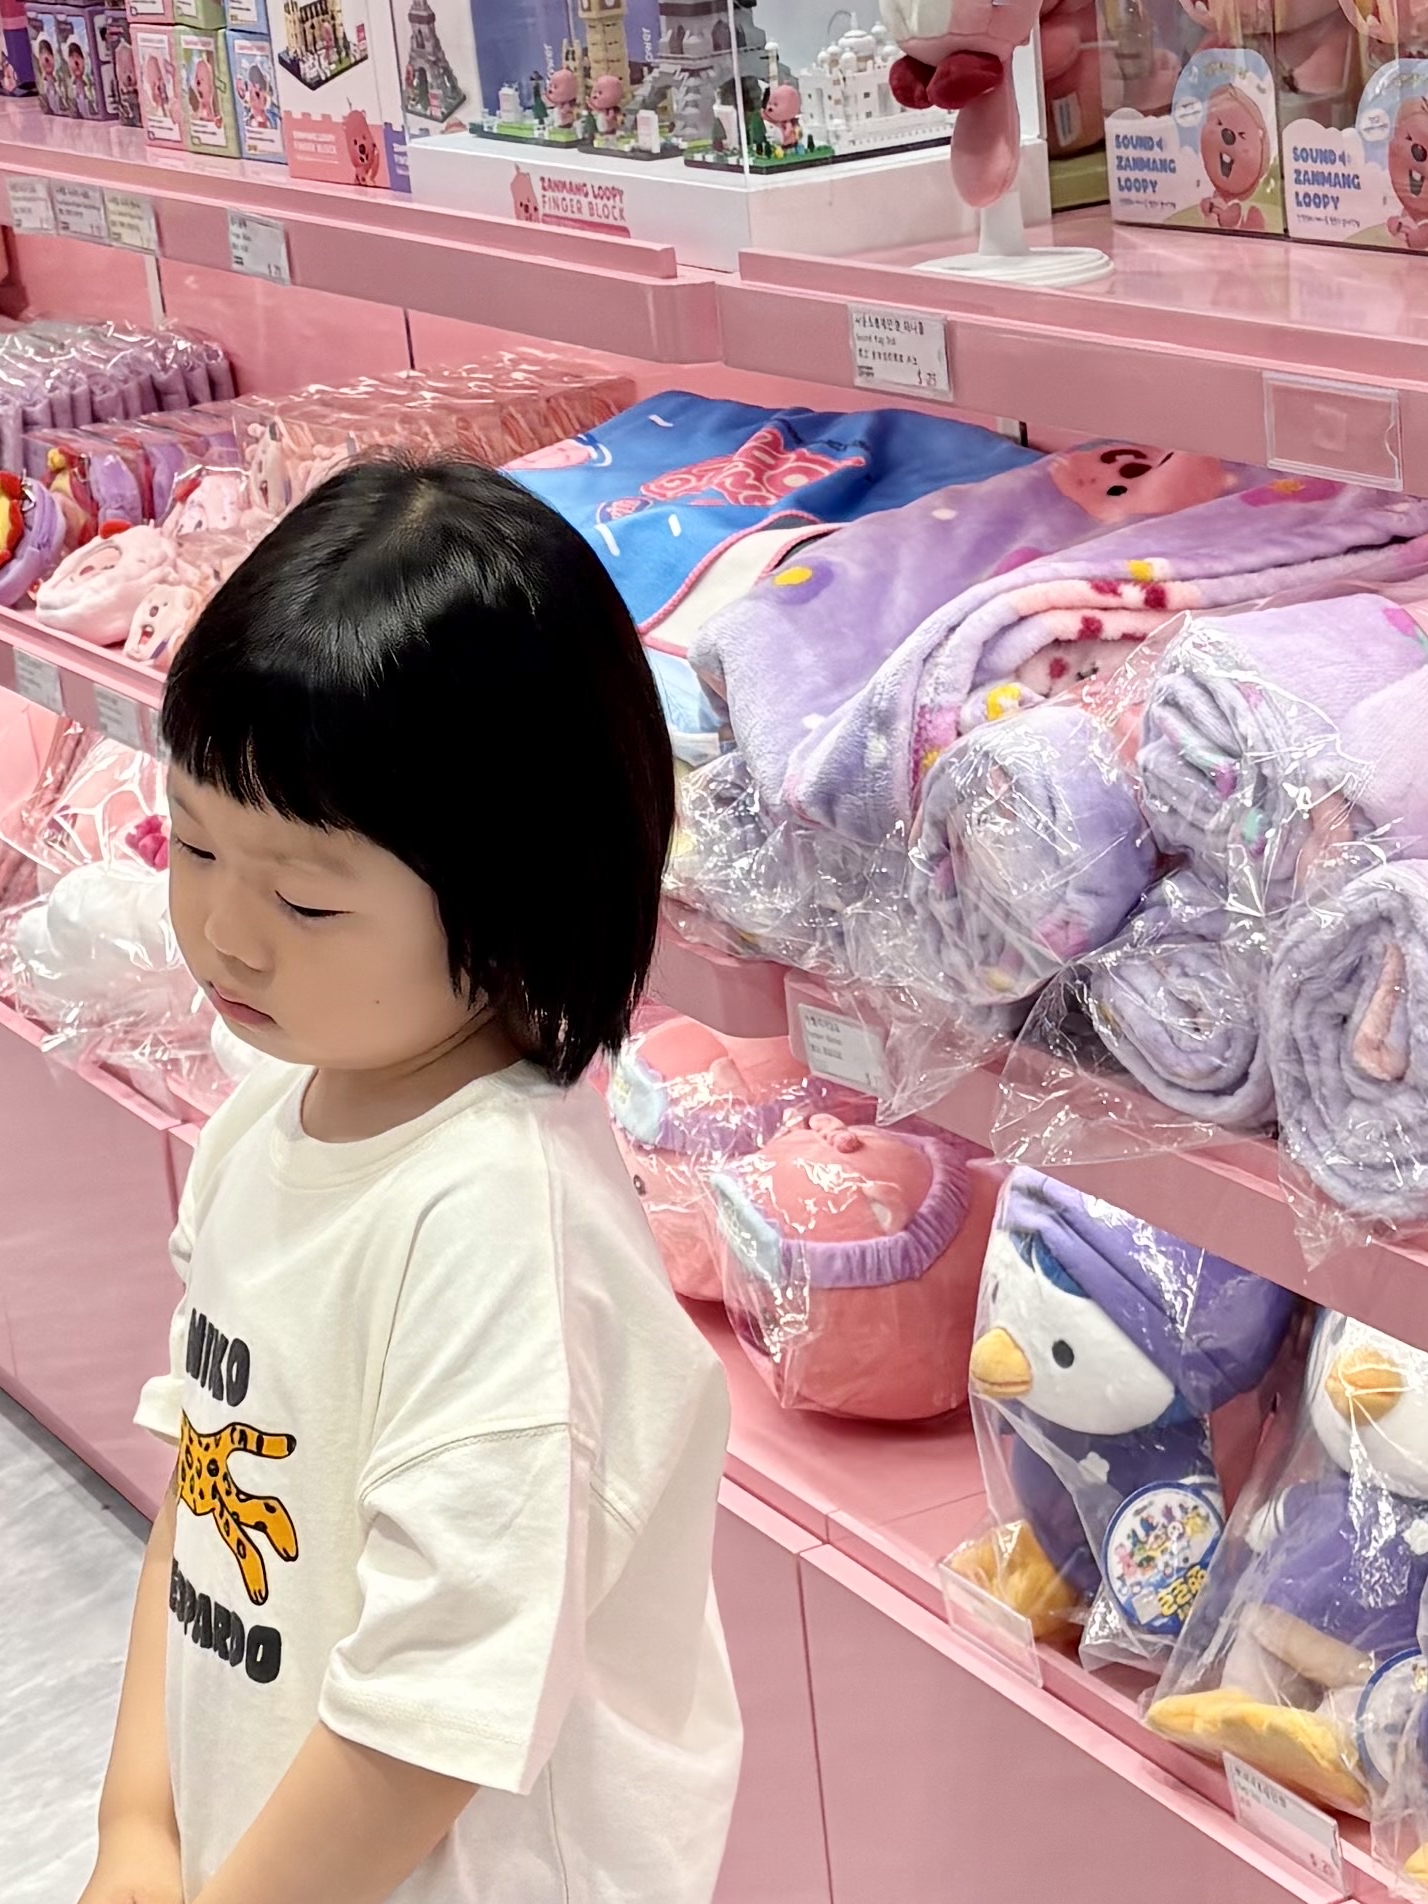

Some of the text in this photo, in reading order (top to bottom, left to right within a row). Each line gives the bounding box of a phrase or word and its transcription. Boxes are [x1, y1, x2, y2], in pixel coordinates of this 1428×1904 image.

[1115, 134, 1155, 151] SOUND
[1292, 146, 1335, 165] SOUND
[1117, 177, 1157, 194] LOOPY
[1294, 169, 1361, 190] ZANMANG
[541, 176, 625, 204] ZANMANG LOOPY
[542, 196, 626, 223] FINGER BLOCK
[1295, 192, 1340, 210] LOOPY
